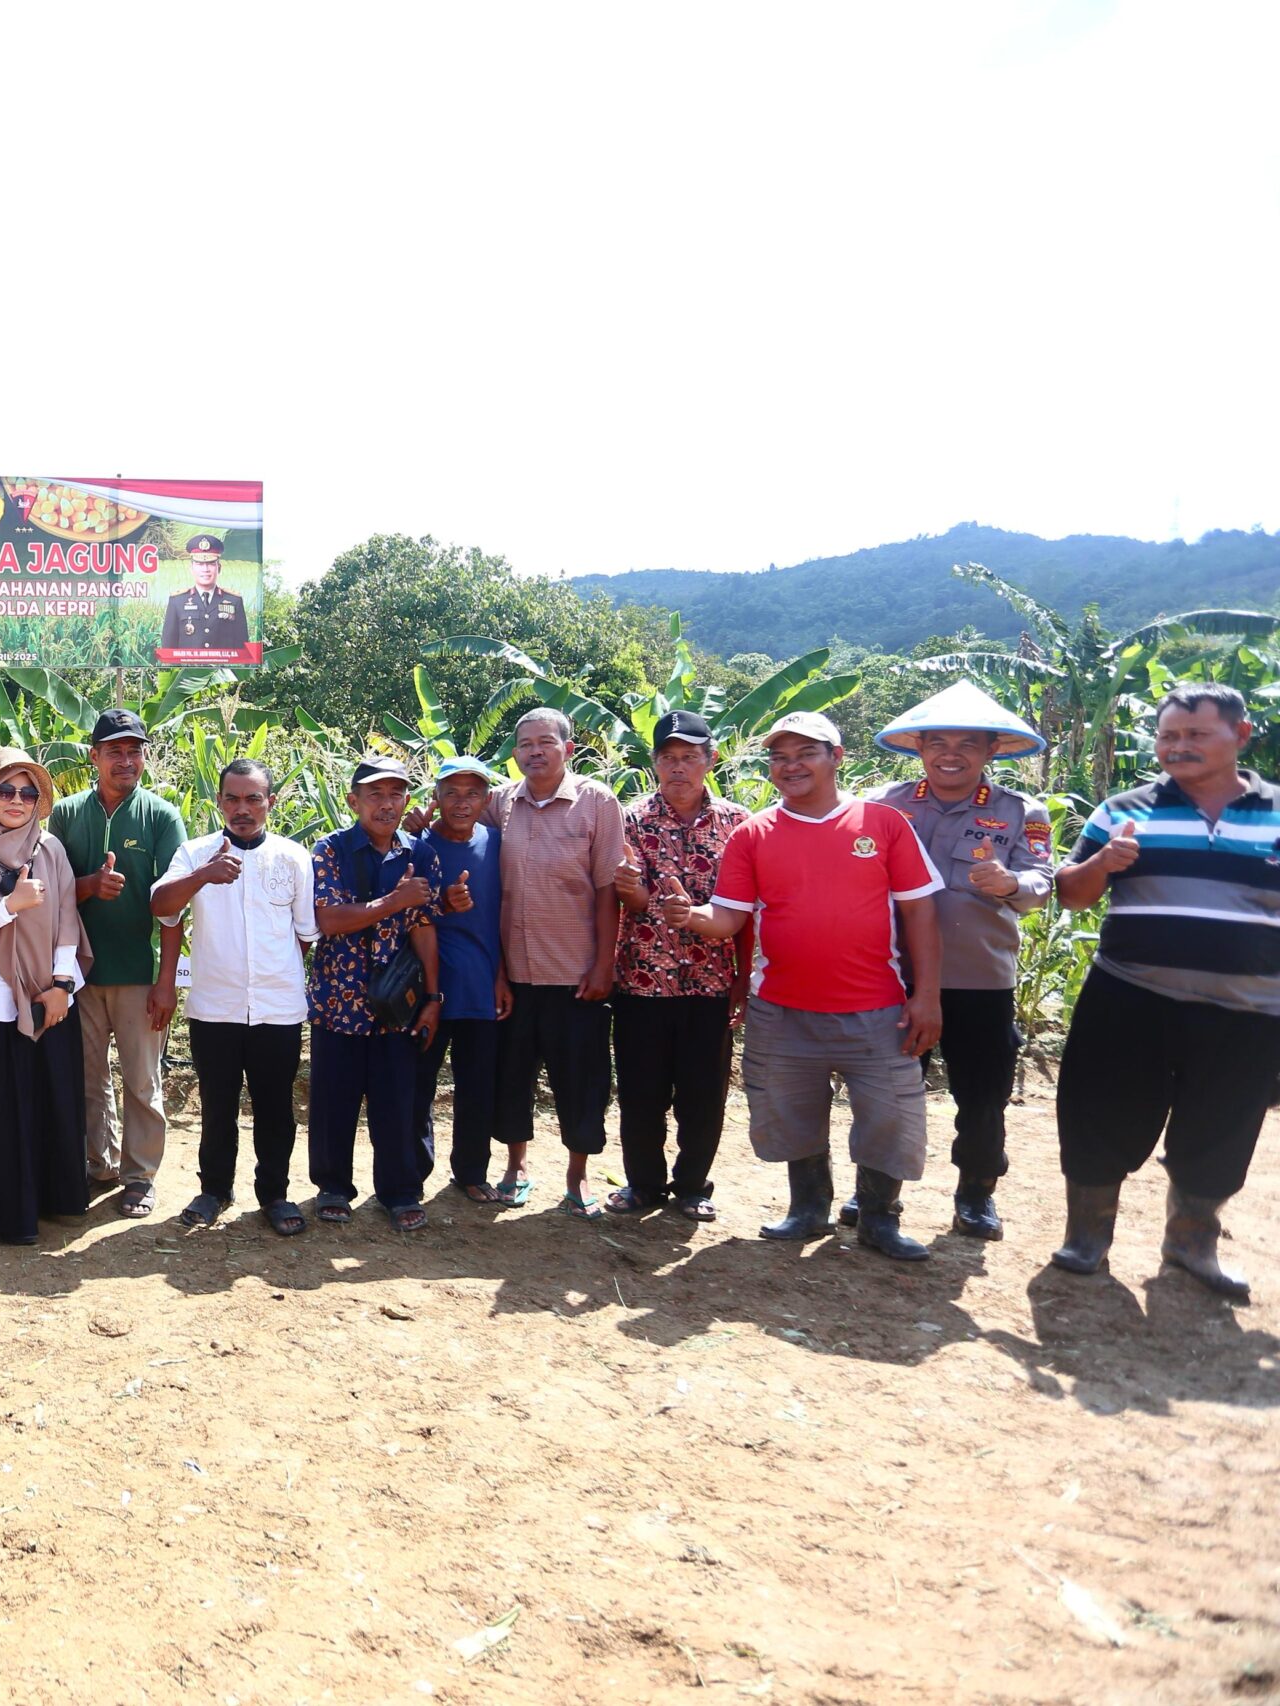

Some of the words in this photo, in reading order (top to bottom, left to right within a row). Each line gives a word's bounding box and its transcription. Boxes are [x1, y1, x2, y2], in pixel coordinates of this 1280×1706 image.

[26, 542, 159, 574] JAGUNG
[77, 582, 147, 597] PANGAN
[45, 601, 96, 616] KEPRI
[14, 653, 37, 661] 2025
[964, 829, 1008, 846] PORI
